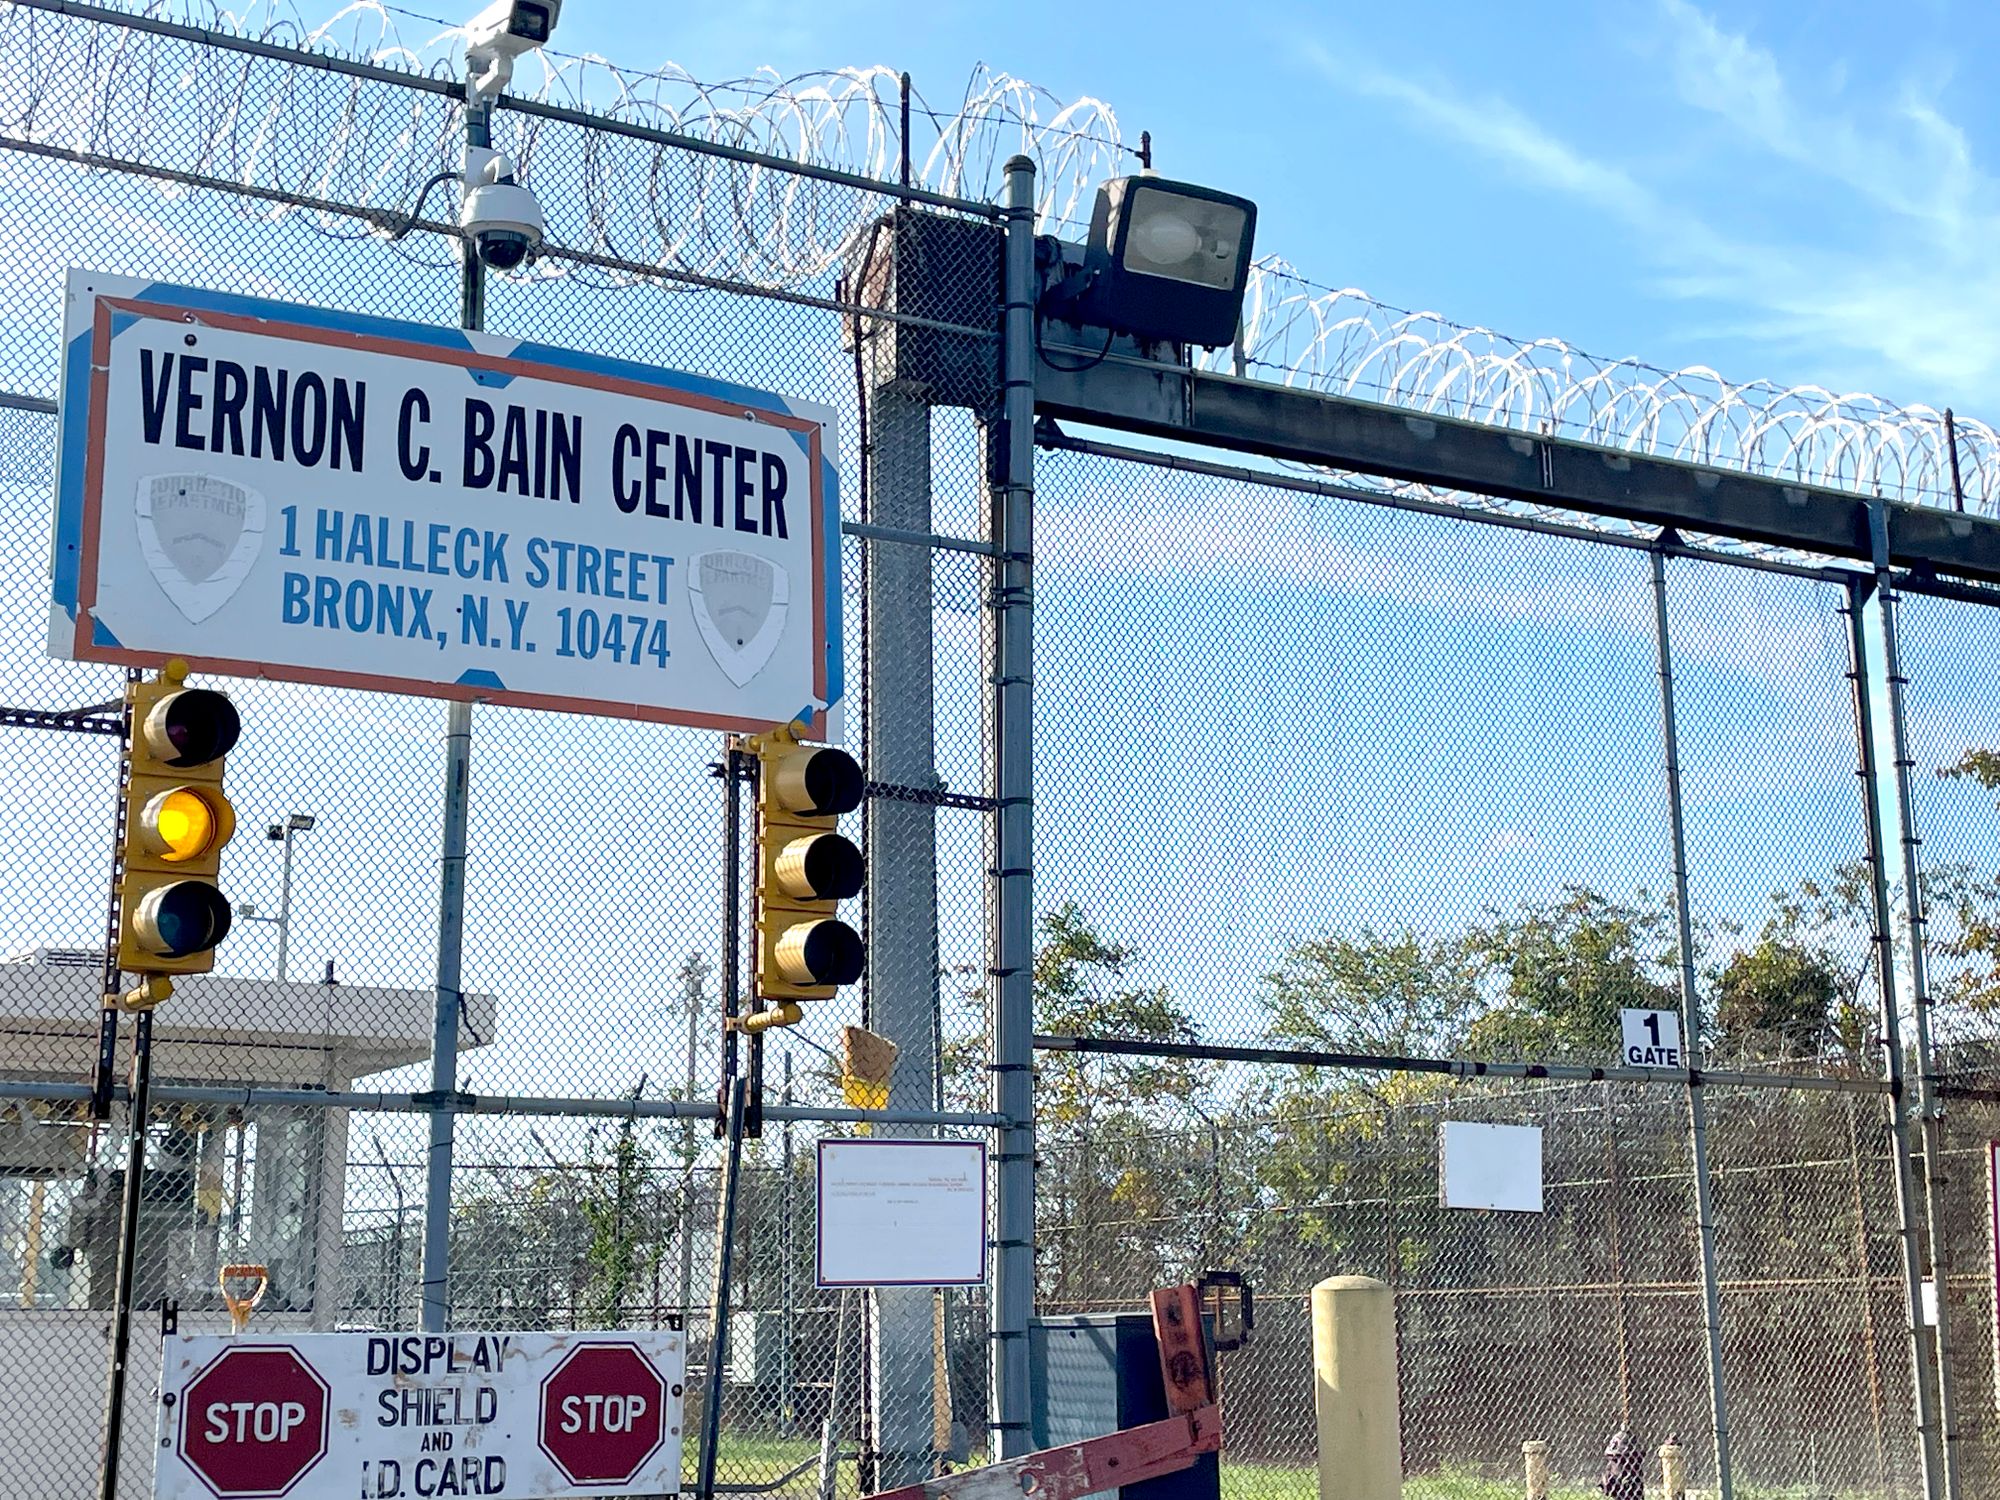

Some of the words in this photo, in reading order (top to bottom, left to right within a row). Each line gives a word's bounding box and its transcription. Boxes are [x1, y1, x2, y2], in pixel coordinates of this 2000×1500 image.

[140, 349, 366, 473] VERNON
[398, 388, 442, 484] C.
[463, 398, 582, 504] BAIN
[613, 424, 789, 540] CENTER
[280, 505, 301, 557] 1
[316, 509, 510, 584] HALLECK
[526, 537, 675, 605] STREET
[282, 572, 448, 651] BRONX,
[458, 594, 537, 653] N.Y.
[556, 607, 671, 669] 10474
[1643, 1012, 1660, 1047] 1
[1628, 1046, 1678, 1066] GATE
[366, 1336, 512, 1376] DISPLAY
[204, 1401, 307, 1444] STOP
[377, 1386, 498, 1428] SHIELD
[560, 1394, 648, 1434] STOP
[420, 1431, 454, 1452] AND
[415, 1455, 507, 1498] CARD
